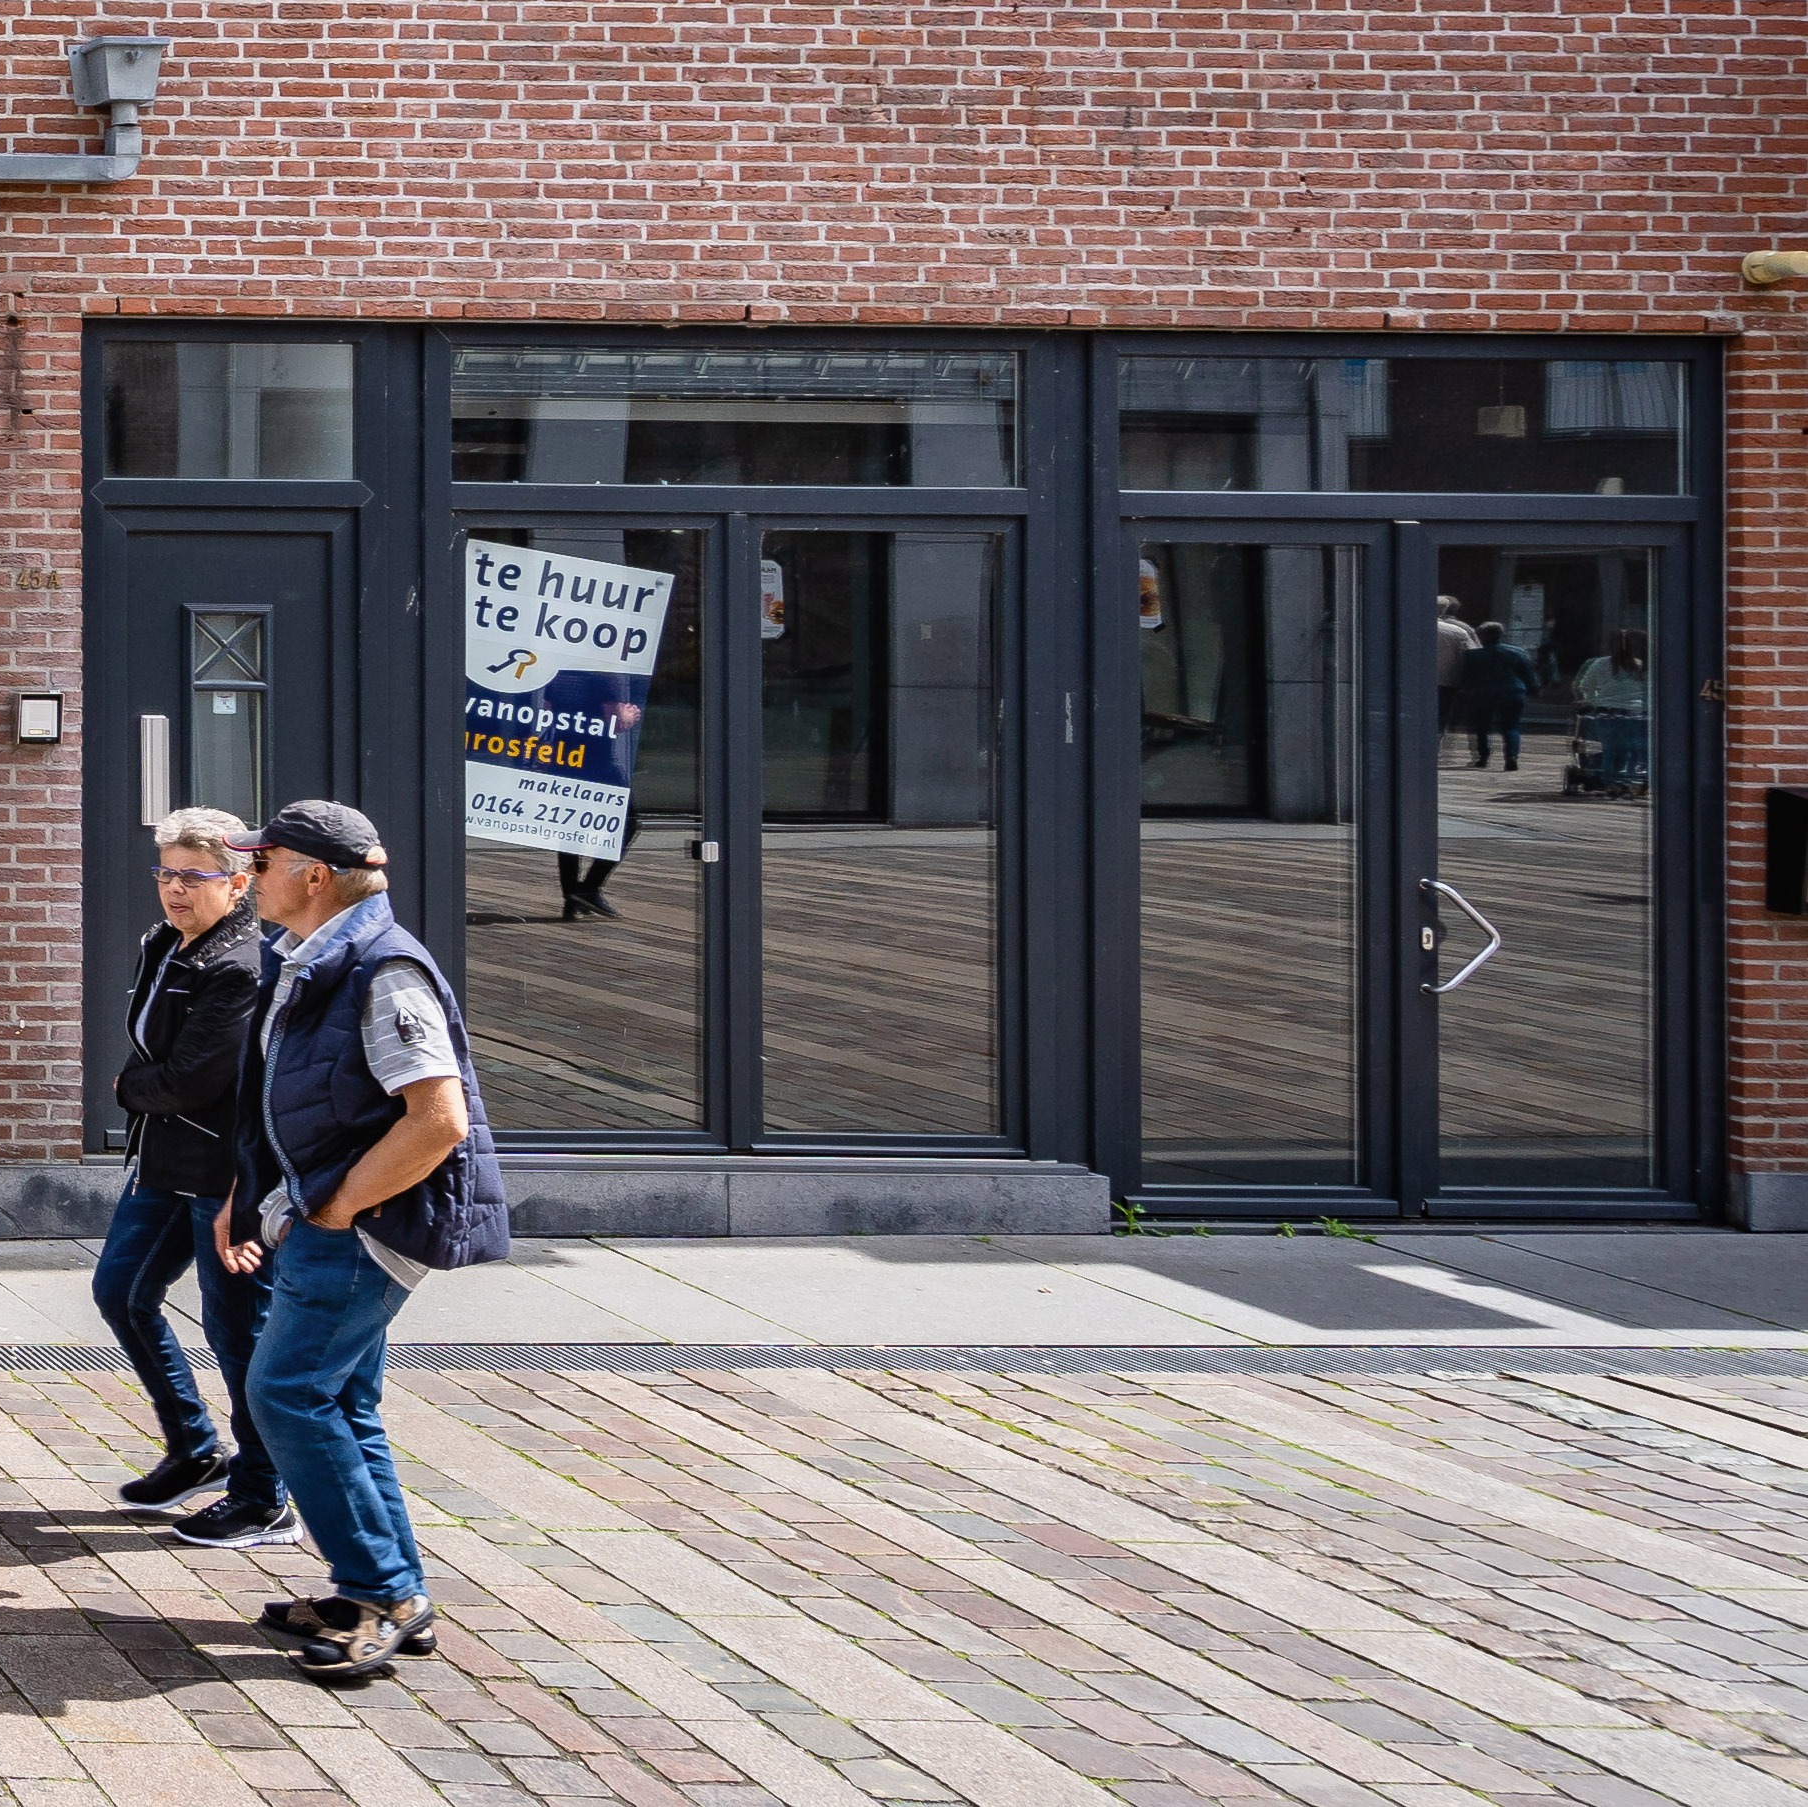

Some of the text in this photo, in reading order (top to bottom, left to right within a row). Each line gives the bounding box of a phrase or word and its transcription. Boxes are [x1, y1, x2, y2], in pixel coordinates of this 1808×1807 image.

[16, 567, 41, 589] 45
[475, 553, 654, 613] te huur
[474, 594, 648, 661] te koop
[465, 731, 585, 768] rosfeld
[518, 778, 625, 806] makelaars
[471, 793, 620, 833] 0164 217 000
